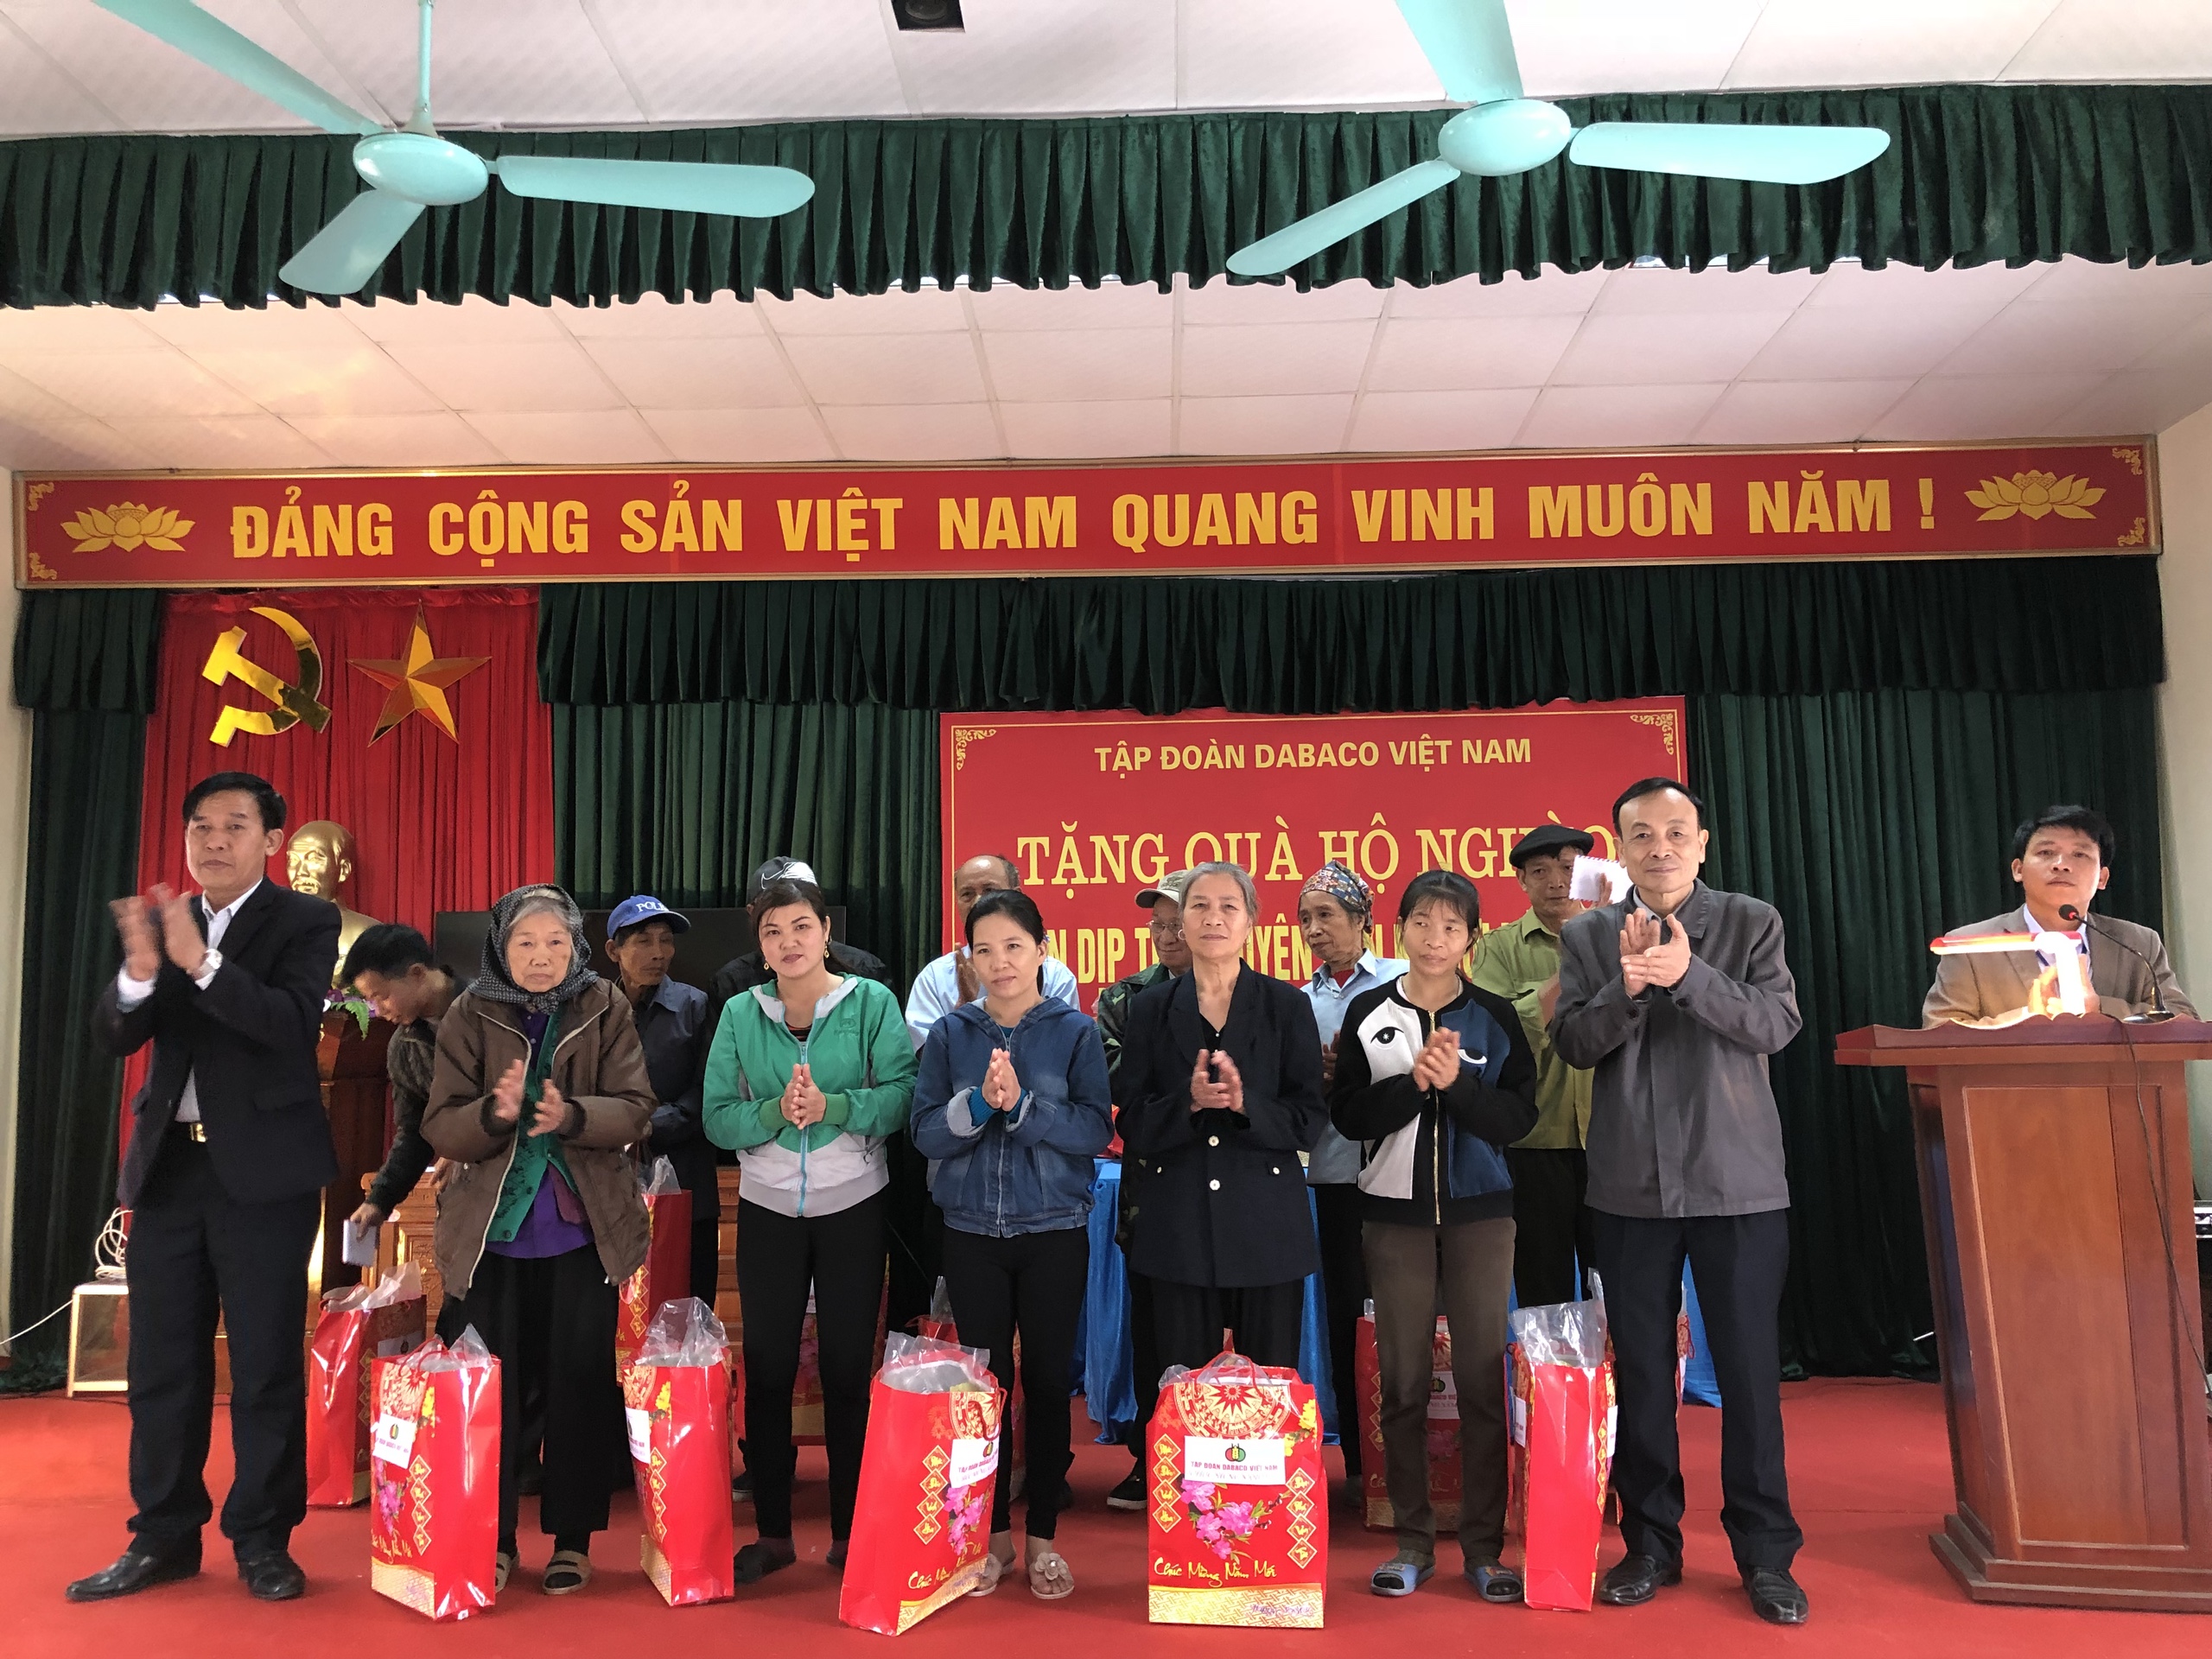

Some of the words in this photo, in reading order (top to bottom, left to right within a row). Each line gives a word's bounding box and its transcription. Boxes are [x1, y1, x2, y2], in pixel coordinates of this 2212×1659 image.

[231, 485, 394, 558] ĐẢNG
[428, 489, 590, 567] CỘNG
[620, 480, 744, 553] SẢN
[776, 487, 903, 562] VIỆT
[938, 495, 1077, 550] NAM
[1111, 491, 1319, 553] QUANG
[1351, 487, 1495, 542] VINH
[1529, 473, 1713, 538] MUÔN
[1747, 469, 1891, 534] NĂM
[1094, 740, 1152, 779] TẬP
[1160, 739, 1245, 770] ĐOÀN
[1255, 741, 1380, 768] DABACO
[1388, 733, 1452, 772] VIỆT
[1462, 738, 1531, 764] NAM
[1016, 820, 1170, 899] TẶNG
[1318, 811, 1400, 894] HỘ
